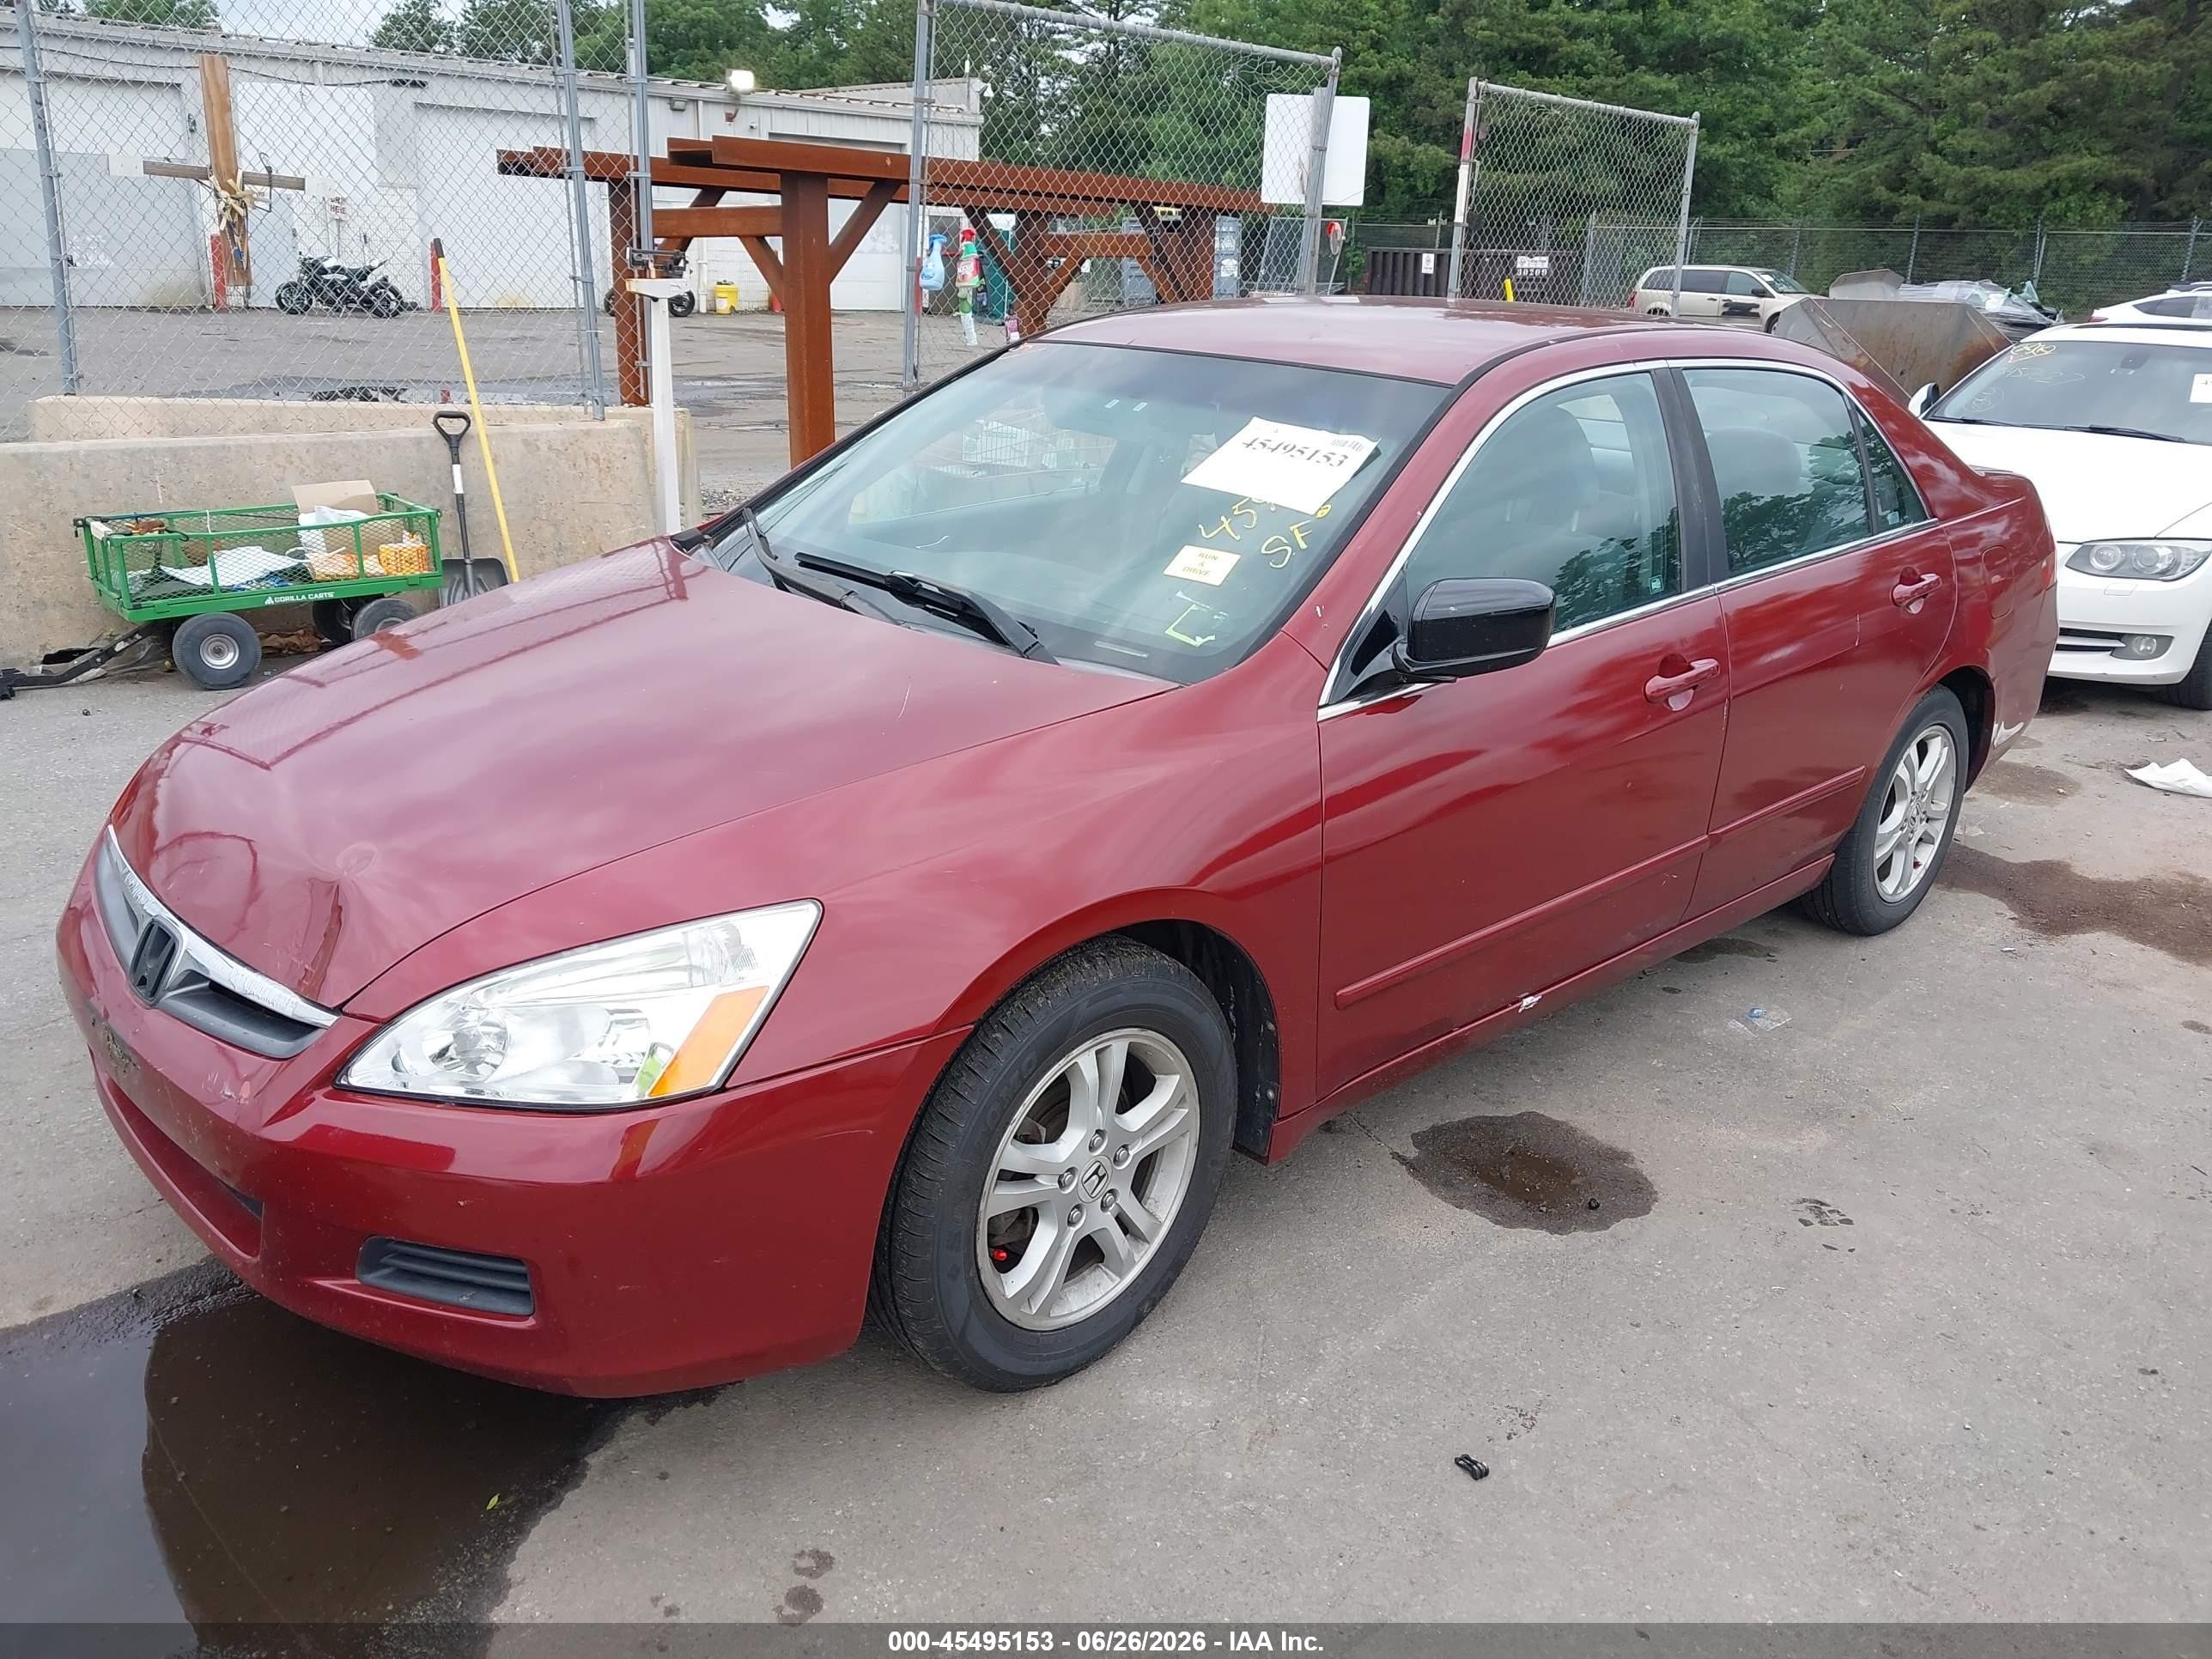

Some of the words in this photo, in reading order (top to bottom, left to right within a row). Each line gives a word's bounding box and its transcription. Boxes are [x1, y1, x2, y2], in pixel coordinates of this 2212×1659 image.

[1243, 437, 1349, 467] 45495153
[1197, 552, 1218, 561] RUN
[1182, 566, 1211, 576] DRIVE
[274, 594, 307, 603] GORILLA
